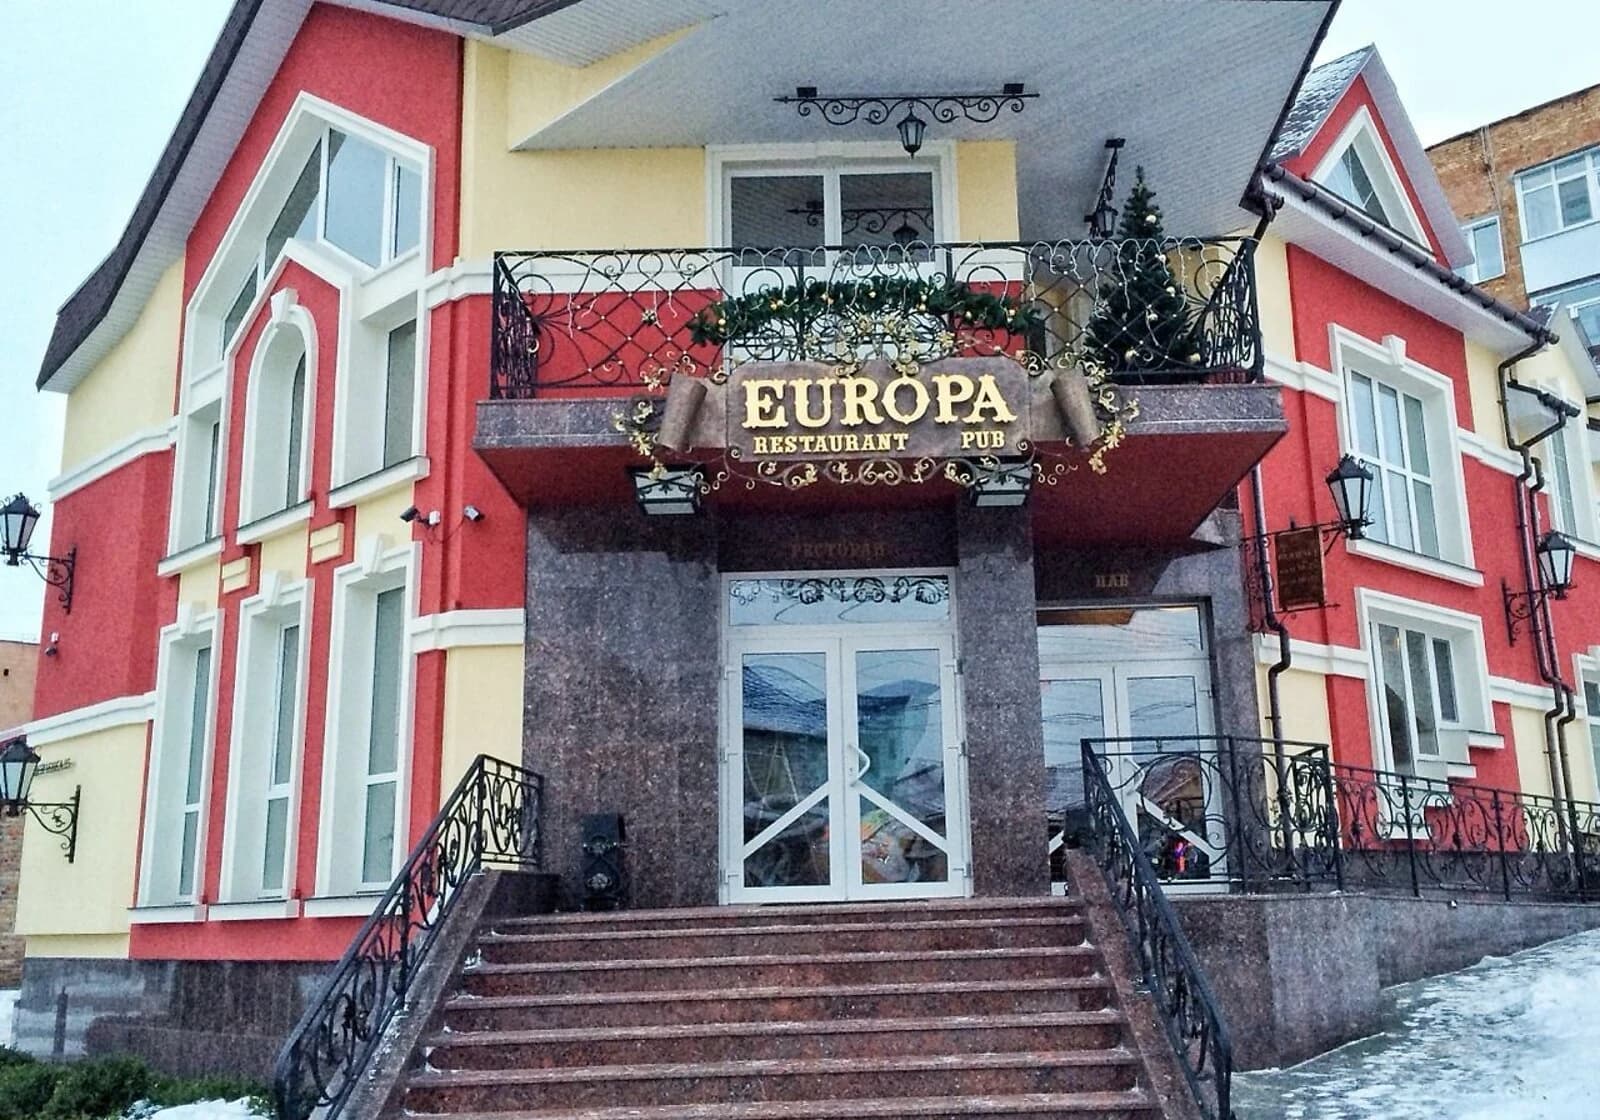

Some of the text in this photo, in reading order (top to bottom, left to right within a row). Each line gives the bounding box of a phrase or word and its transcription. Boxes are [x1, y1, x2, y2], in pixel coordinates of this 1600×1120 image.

[742, 374, 1018, 429] EUROPA
[753, 430, 1005, 454] RESTAURANT PUB
